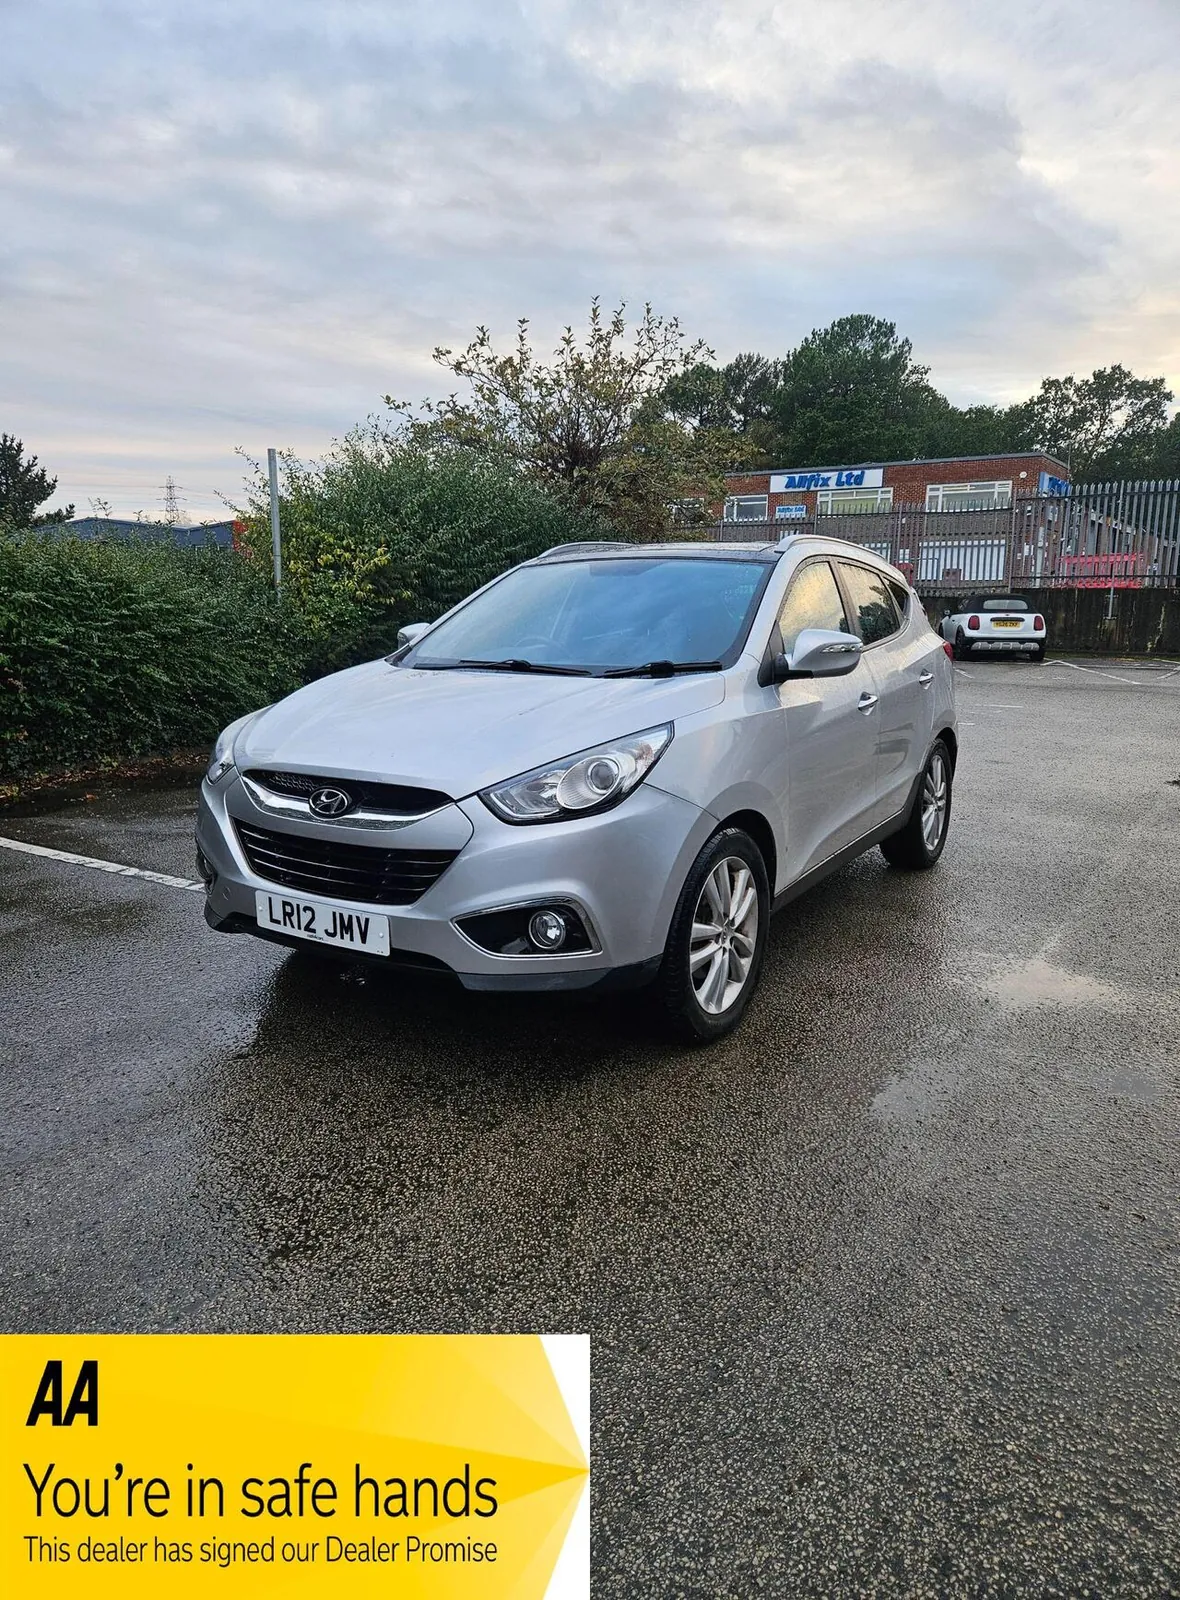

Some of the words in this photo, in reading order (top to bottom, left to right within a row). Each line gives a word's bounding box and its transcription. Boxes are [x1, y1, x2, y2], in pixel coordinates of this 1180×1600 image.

[785, 473, 831, 490] Allfix
[836, 471, 865, 487] Ltd
[268, 896, 316, 934] LR12
[324, 911, 369, 944] JMV
